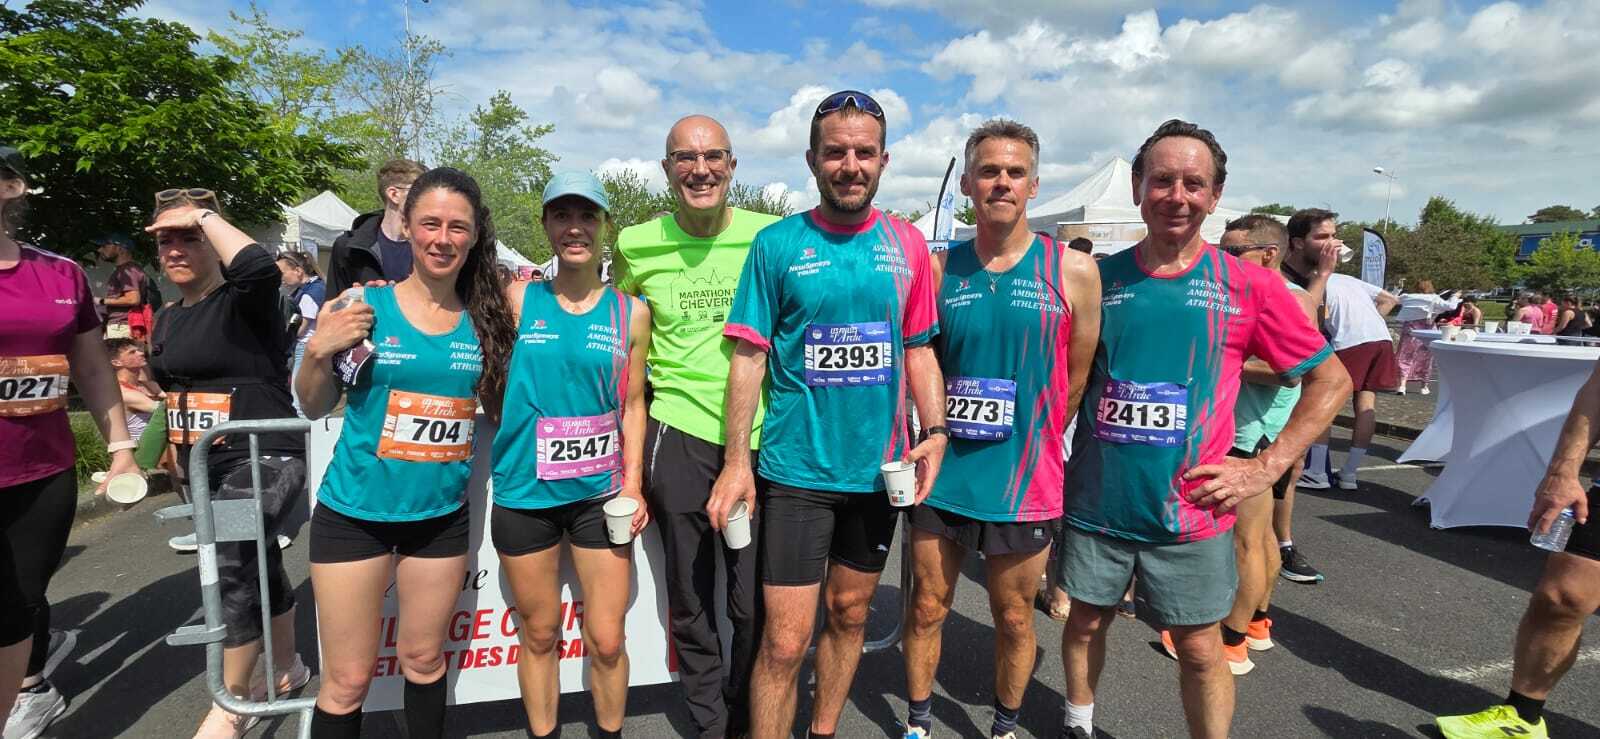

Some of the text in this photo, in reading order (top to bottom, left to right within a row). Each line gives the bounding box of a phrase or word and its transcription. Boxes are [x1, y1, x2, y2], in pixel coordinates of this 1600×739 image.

[1011, 278, 1044, 290] AVENIR
[1188, 278, 1223, 292] AVENIR
[679, 288, 731, 300] MARATHON
[1010, 288, 1049, 302] AMBOISE
[1186, 289, 1230, 303] AMBOISE
[1009, 300, 1065, 315] ATHLETISME
[1184, 298, 1243, 316] ATHLETISME
[587, 323, 619, 337] AVENIR
[586, 333, 623, 347] AMBOISE
[818, 344, 879, 369] 2393
[946, 396, 999, 422] 2273
[1105, 400, 1170, 429] 2413
[412, 417, 462, 443] 704
[551, 434, 611, 462] 2547
[457, 644, 505, 669] DES
